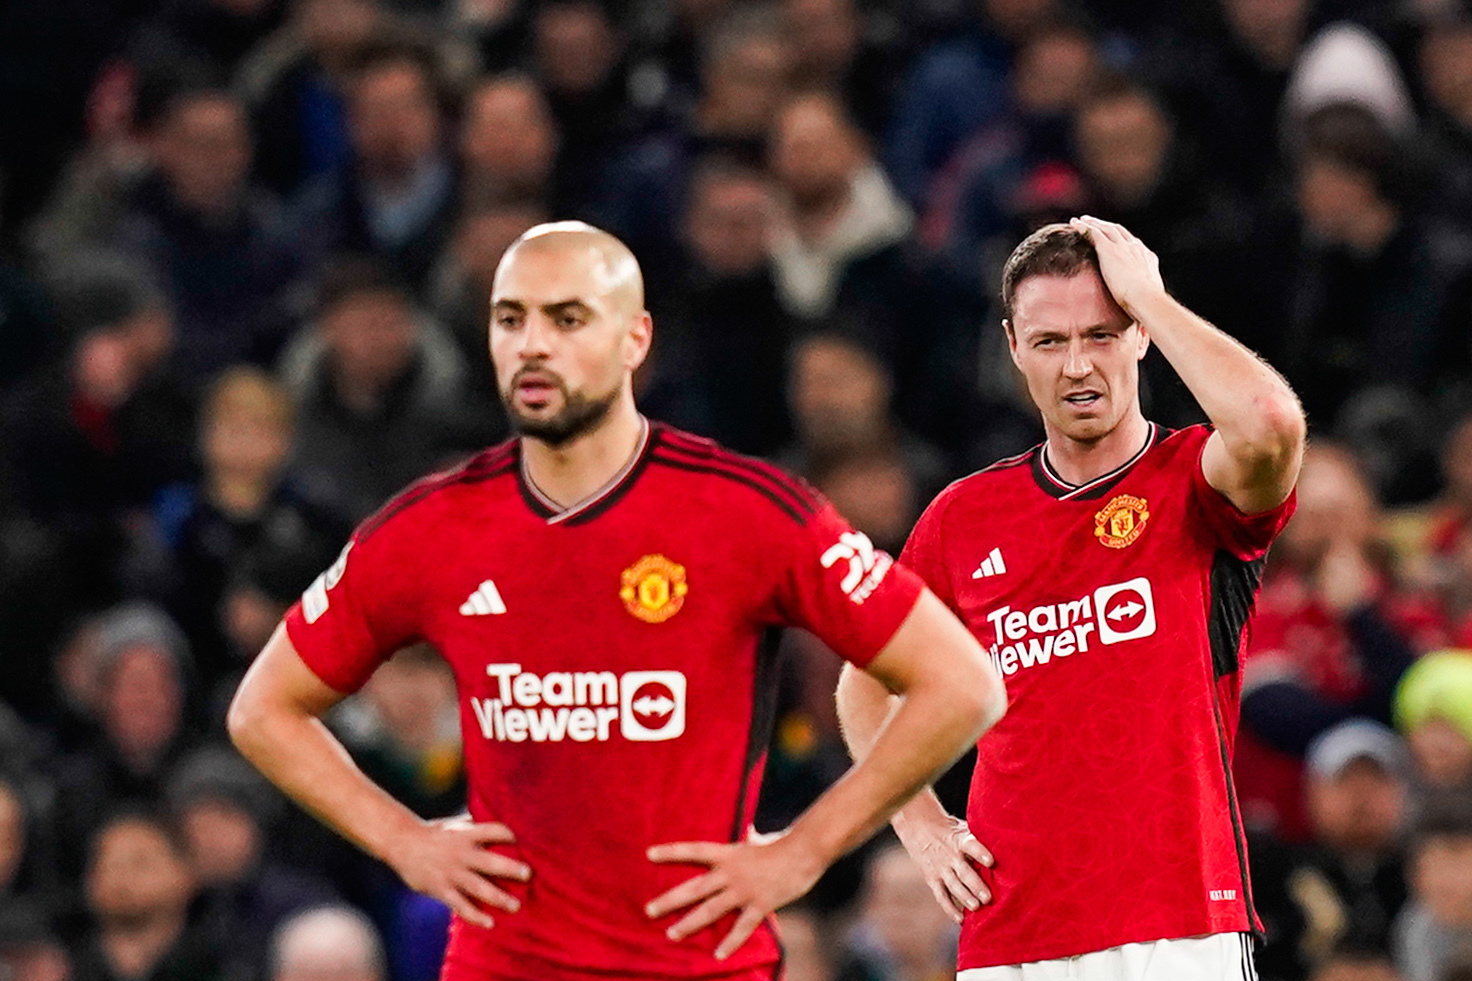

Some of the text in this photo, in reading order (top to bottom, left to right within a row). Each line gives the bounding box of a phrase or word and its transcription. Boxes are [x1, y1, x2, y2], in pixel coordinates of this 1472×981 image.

[986, 595, 1092, 646] Team
[486, 662, 619, 706] Team
[471, 696, 620, 743] Viewer
